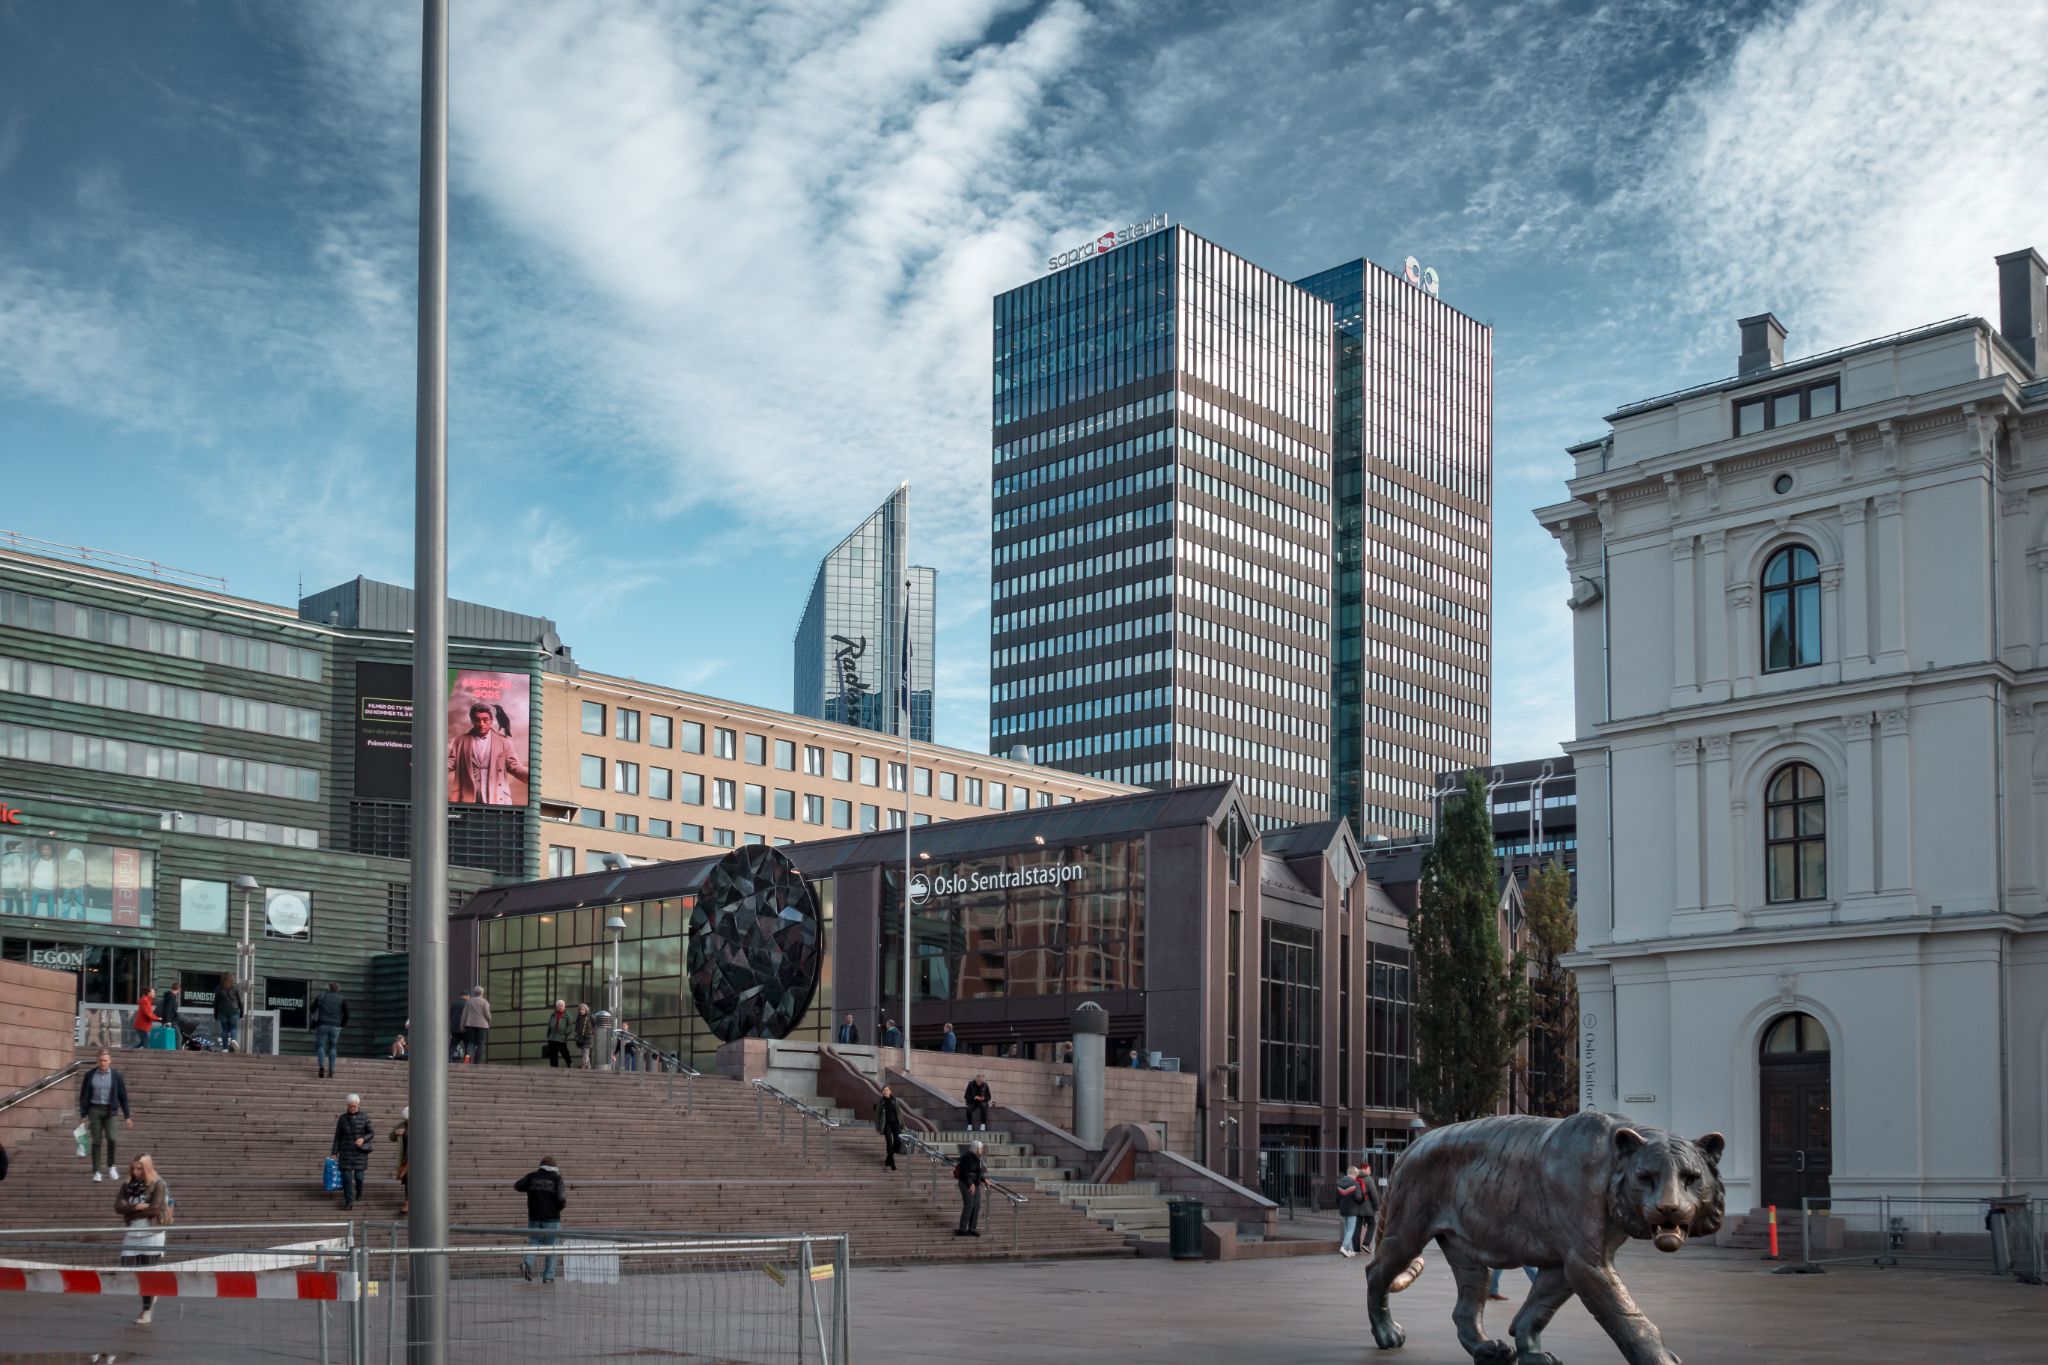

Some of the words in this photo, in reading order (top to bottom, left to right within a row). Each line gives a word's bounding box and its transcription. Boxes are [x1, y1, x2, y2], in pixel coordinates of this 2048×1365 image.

[1048, 240, 1097, 271] sopra
[1117, 212, 1168, 241] steria
[473, 689, 501, 699] GODS
[119, 853, 134, 899] name
[934, 873, 967, 895] Oslo
[970, 862, 1083, 892] Sentralstasjon
[119, 904, 136, 916] it
[32, 949, 83, 965] EGON
[268, 997, 303, 1007] BRANDSTAD
[1584, 1032, 1596, 1059] Oslo
[1584, 1062, 1597, 1100] Visitor
